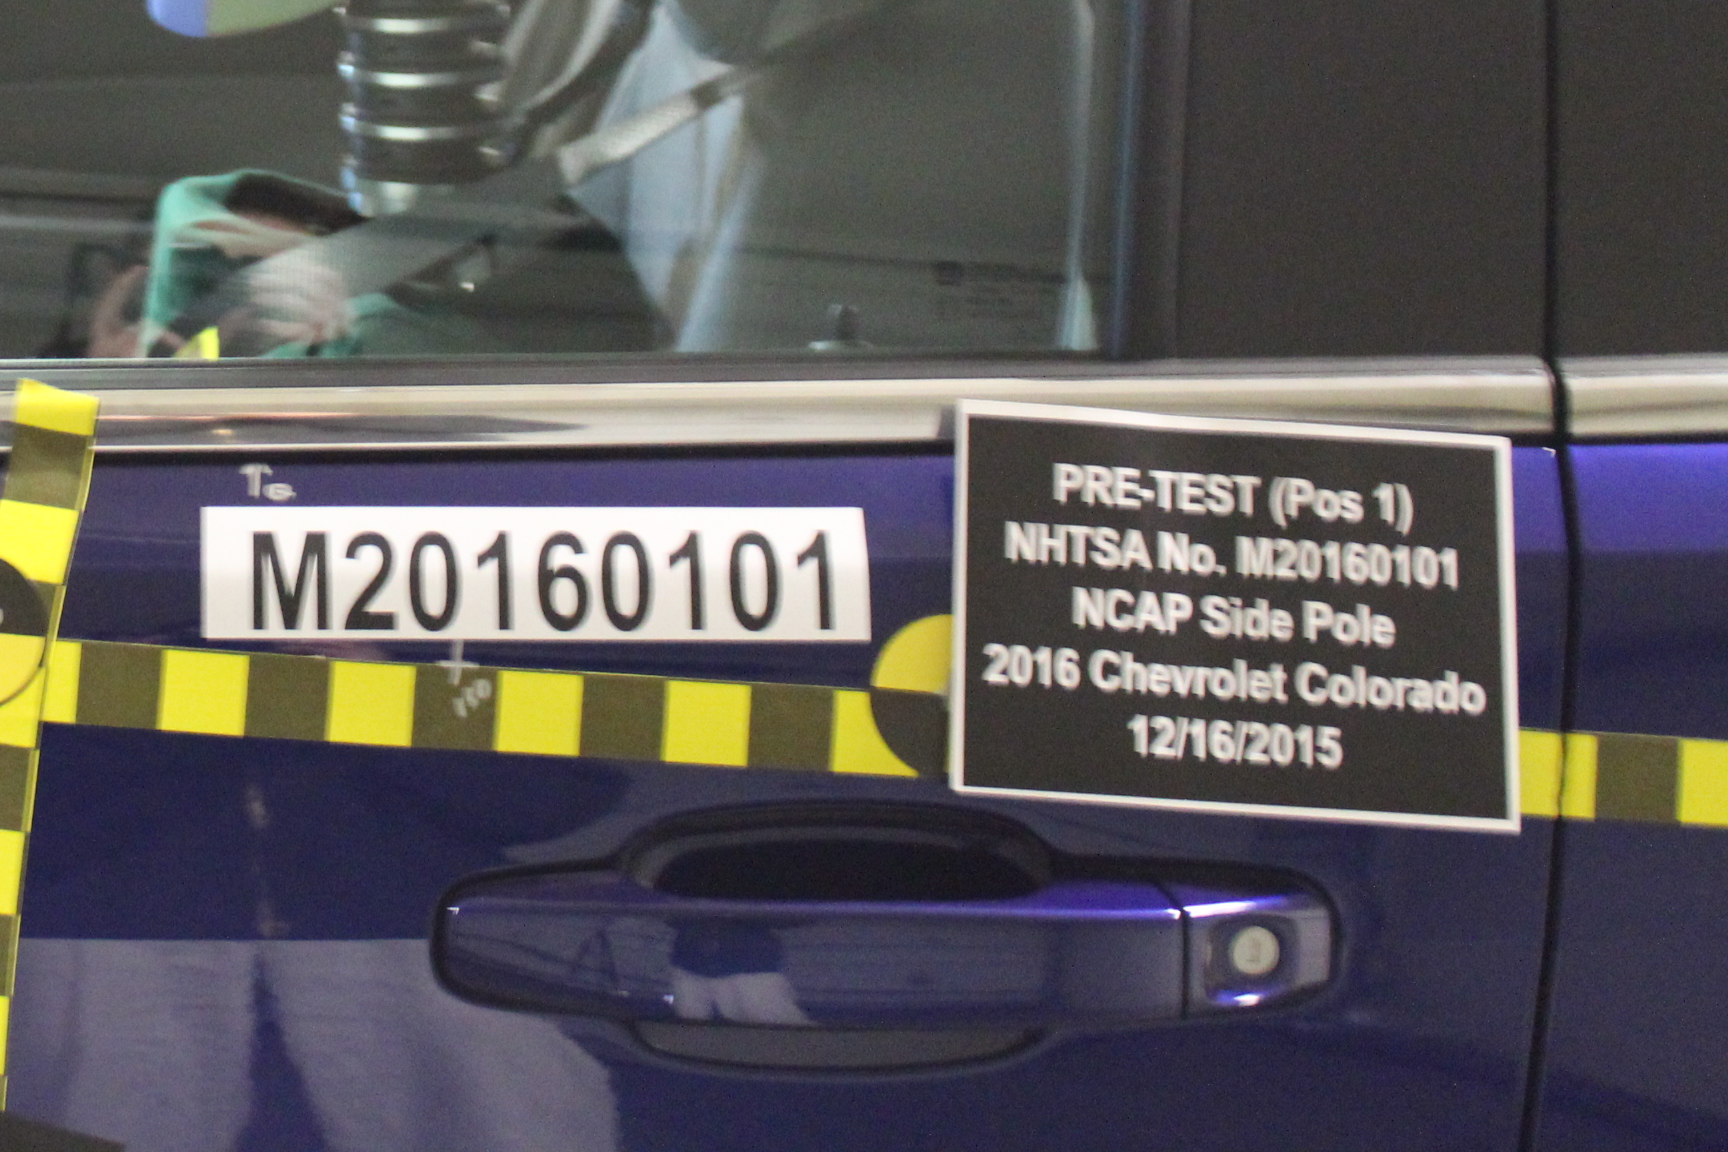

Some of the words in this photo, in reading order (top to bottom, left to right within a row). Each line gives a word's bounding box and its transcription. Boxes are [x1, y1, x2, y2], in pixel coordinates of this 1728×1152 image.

[1053, 462, 1262, 517] PRE-TEST
[1268, 475, 1365, 529] (Pos
[1372, 481, 1415, 536] 1)
[250, 531, 838, 633] M20160101
[1004, 520, 1154, 572] NHTSA
[1156, 530, 1228, 578] No.
[1235, 535, 1460, 591] M20160101
[1072, 586, 1194, 636] NCAP
[1199, 594, 1295, 642] Side
[1302, 600, 1397, 648] Pole
[982, 642, 1082, 691] 2016
[1087, 648, 1289, 705] Chevrolet
[1294, 661, 1488, 717] Colorado
[1127, 713, 1344, 771] 12/16/2015
